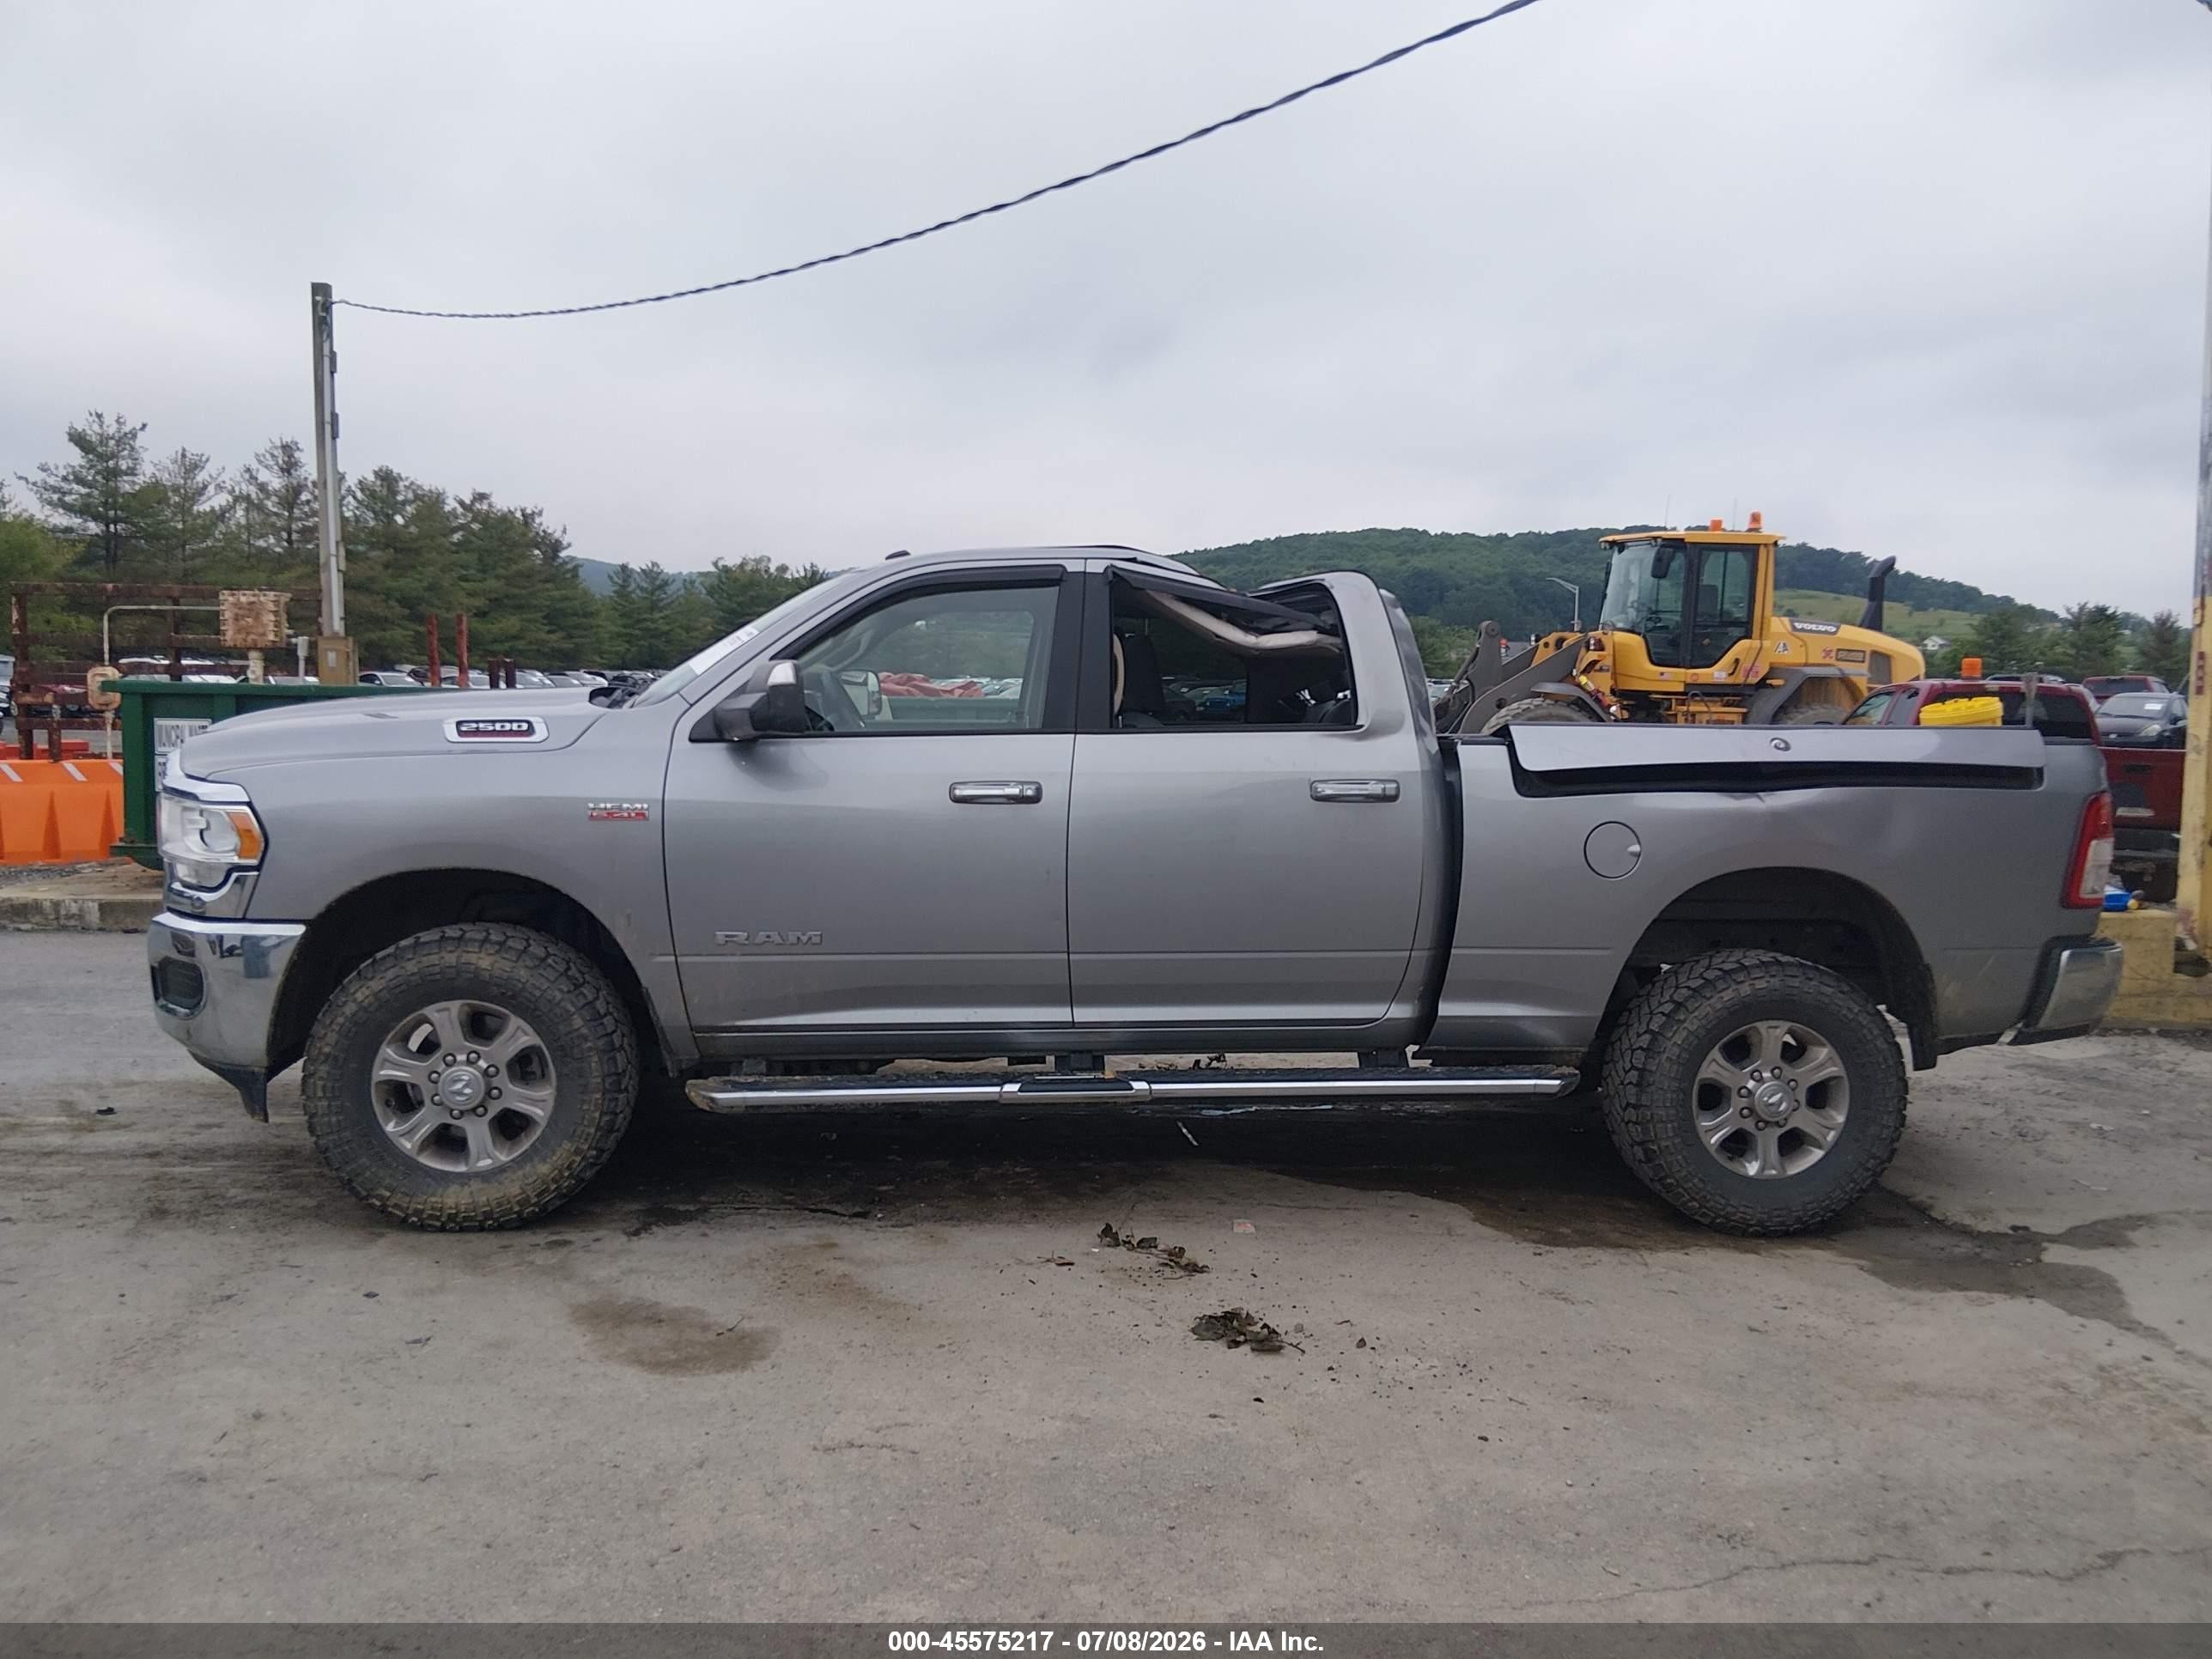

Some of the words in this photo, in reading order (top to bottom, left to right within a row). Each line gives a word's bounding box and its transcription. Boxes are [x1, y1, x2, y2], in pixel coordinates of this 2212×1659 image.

[1793, 622, 1837, 633] VOLVO
[459, 721, 529, 732] 2500
[714, 931, 823, 945] RAM
